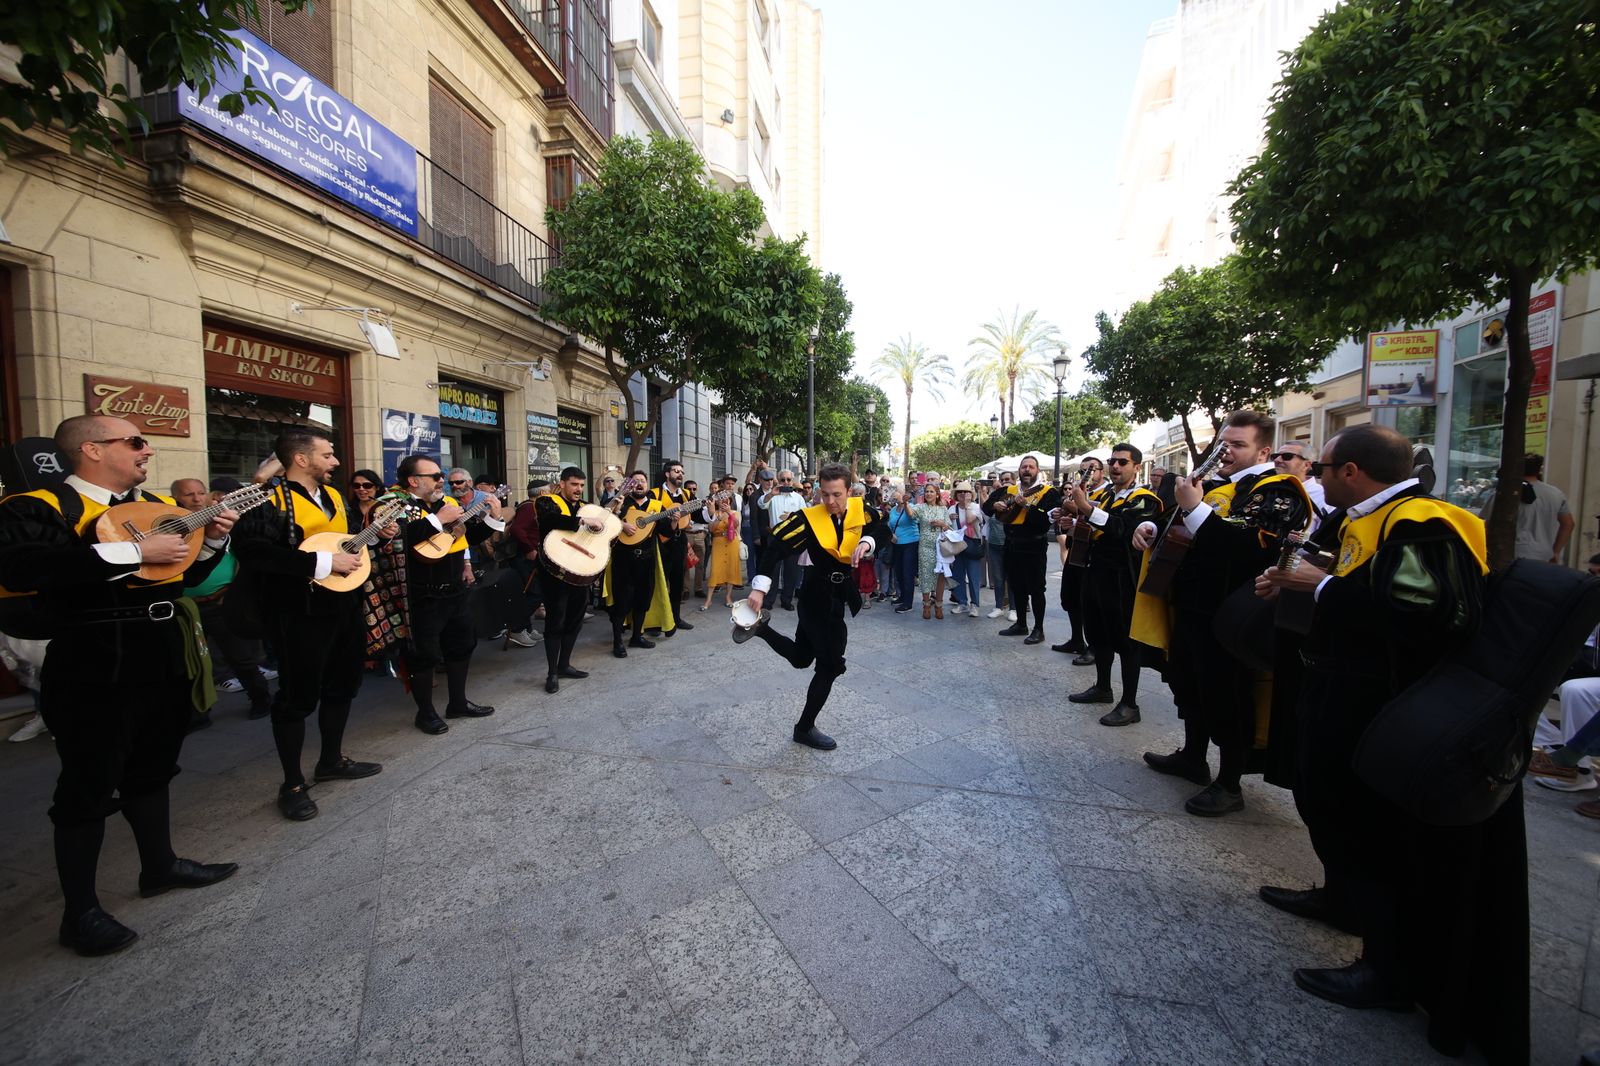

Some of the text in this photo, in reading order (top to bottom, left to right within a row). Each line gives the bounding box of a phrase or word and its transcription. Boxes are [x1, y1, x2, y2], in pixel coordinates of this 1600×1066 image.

[242, 40, 383, 160] RAGAL
[187, 95, 234, 128] Gestión
[236, 122, 250, 136] de
[251, 130, 292, 159] Seguros
[299, 157, 358, 196] Comunicación
[358, 190, 365, 199] y
[365, 192, 386, 210] Redes
[387, 205, 414, 225] Sociales
[262, 121, 298, 149] Laboral
[305, 147, 339, 173] Jurídica
[344, 169, 366, 187] Fiscal
[371, 185, 402, 208] Contable
[203, 331, 337, 377] LIMPIEZA
[1390, 336, 1427, 344] KRISTAL
[1405, 346, 1434, 355] KOLOR
[236, 361, 315, 387] EN SECO
[93, 384, 189, 430] Tintelimp
[464, 391, 480, 408] ORO
